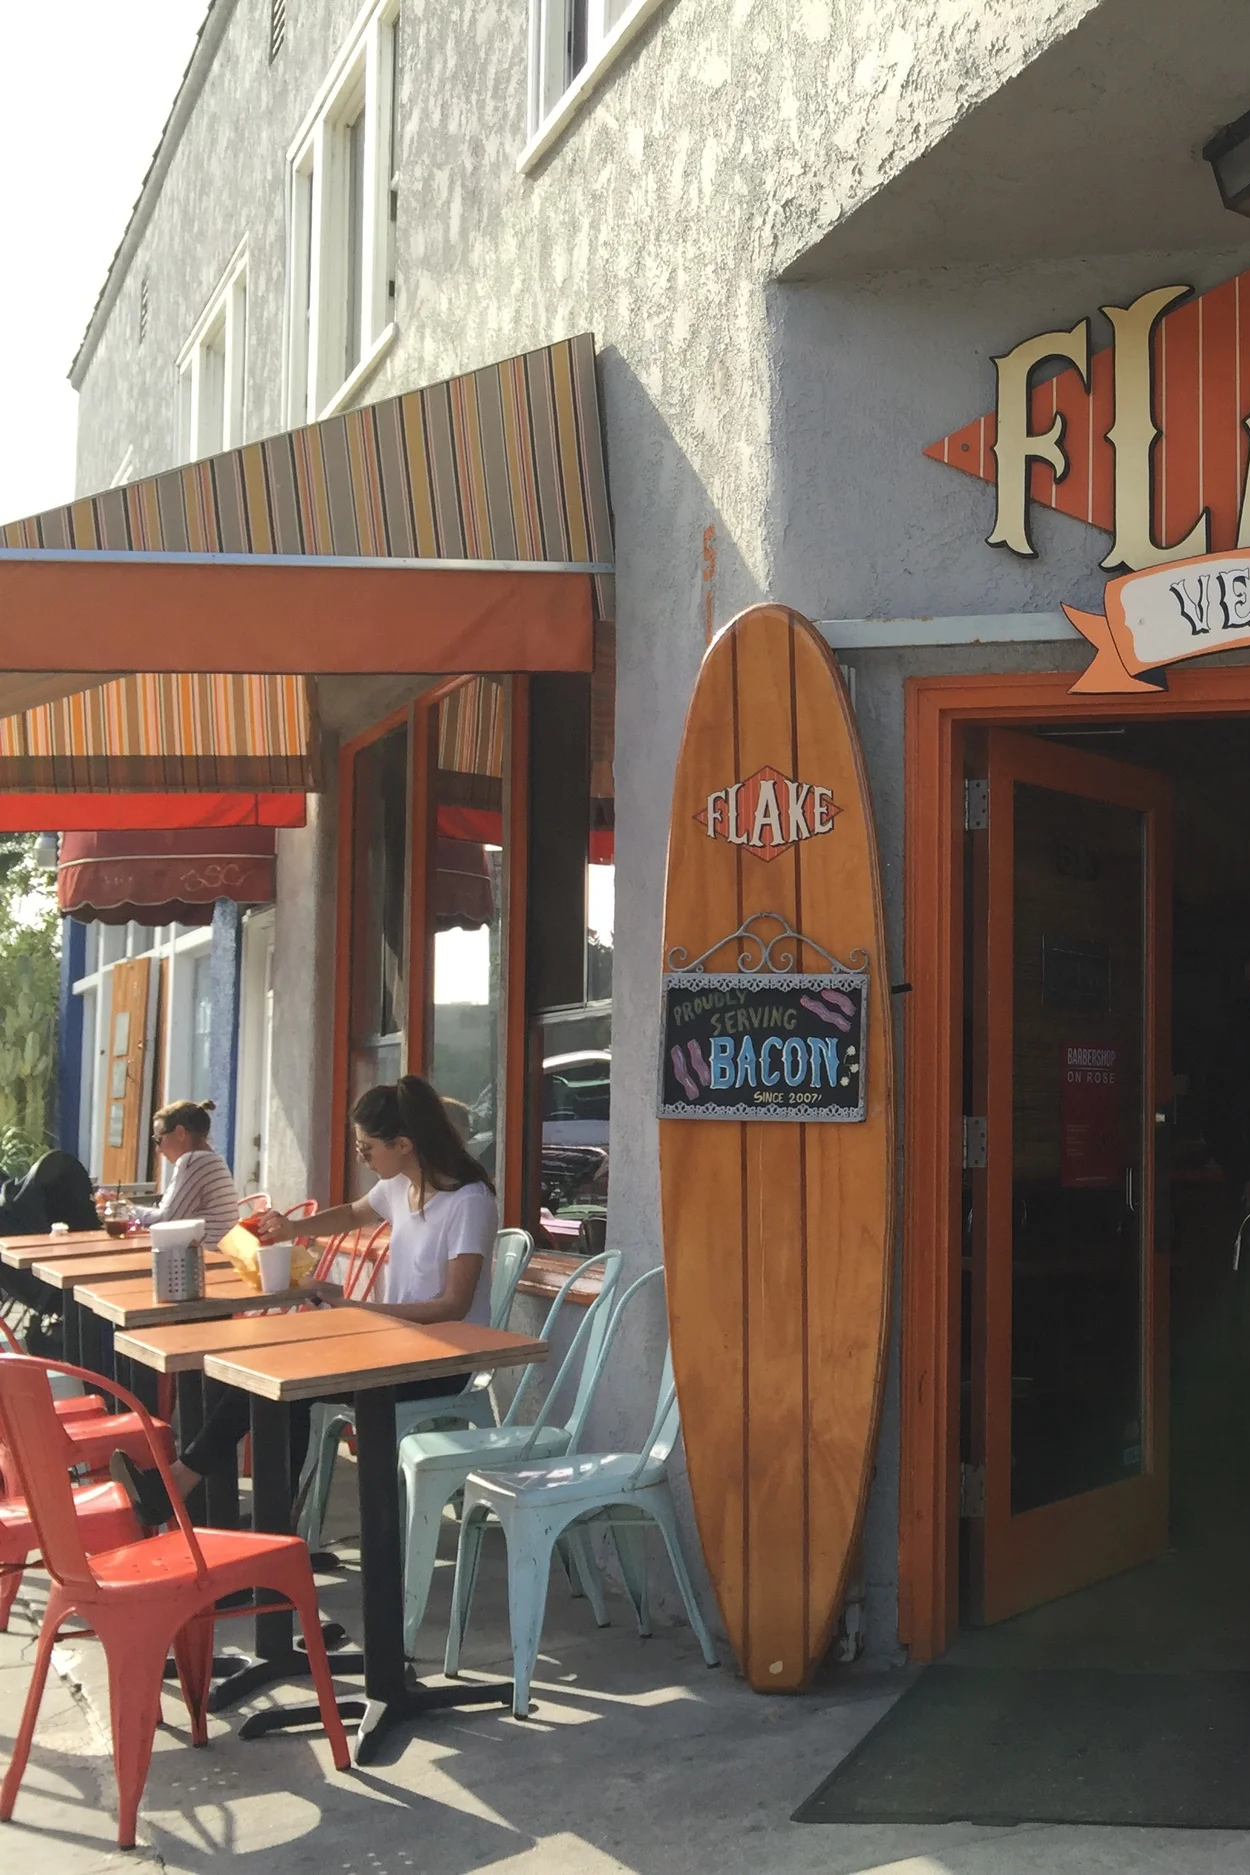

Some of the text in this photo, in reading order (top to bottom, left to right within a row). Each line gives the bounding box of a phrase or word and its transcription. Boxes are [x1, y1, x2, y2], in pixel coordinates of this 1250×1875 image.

[706, 778, 834, 847] FLAKE
[673, 990, 748, 1026] PROUDLY
[711, 1006, 797, 1036] SERVING
[708, 1035, 840, 1089] BACON
[1067, 1047, 1116, 1067] BARBERSHOP
[1067, 1071, 1116, 1084] ON ROSE
[753, 1091, 784, 1103] SINCE
